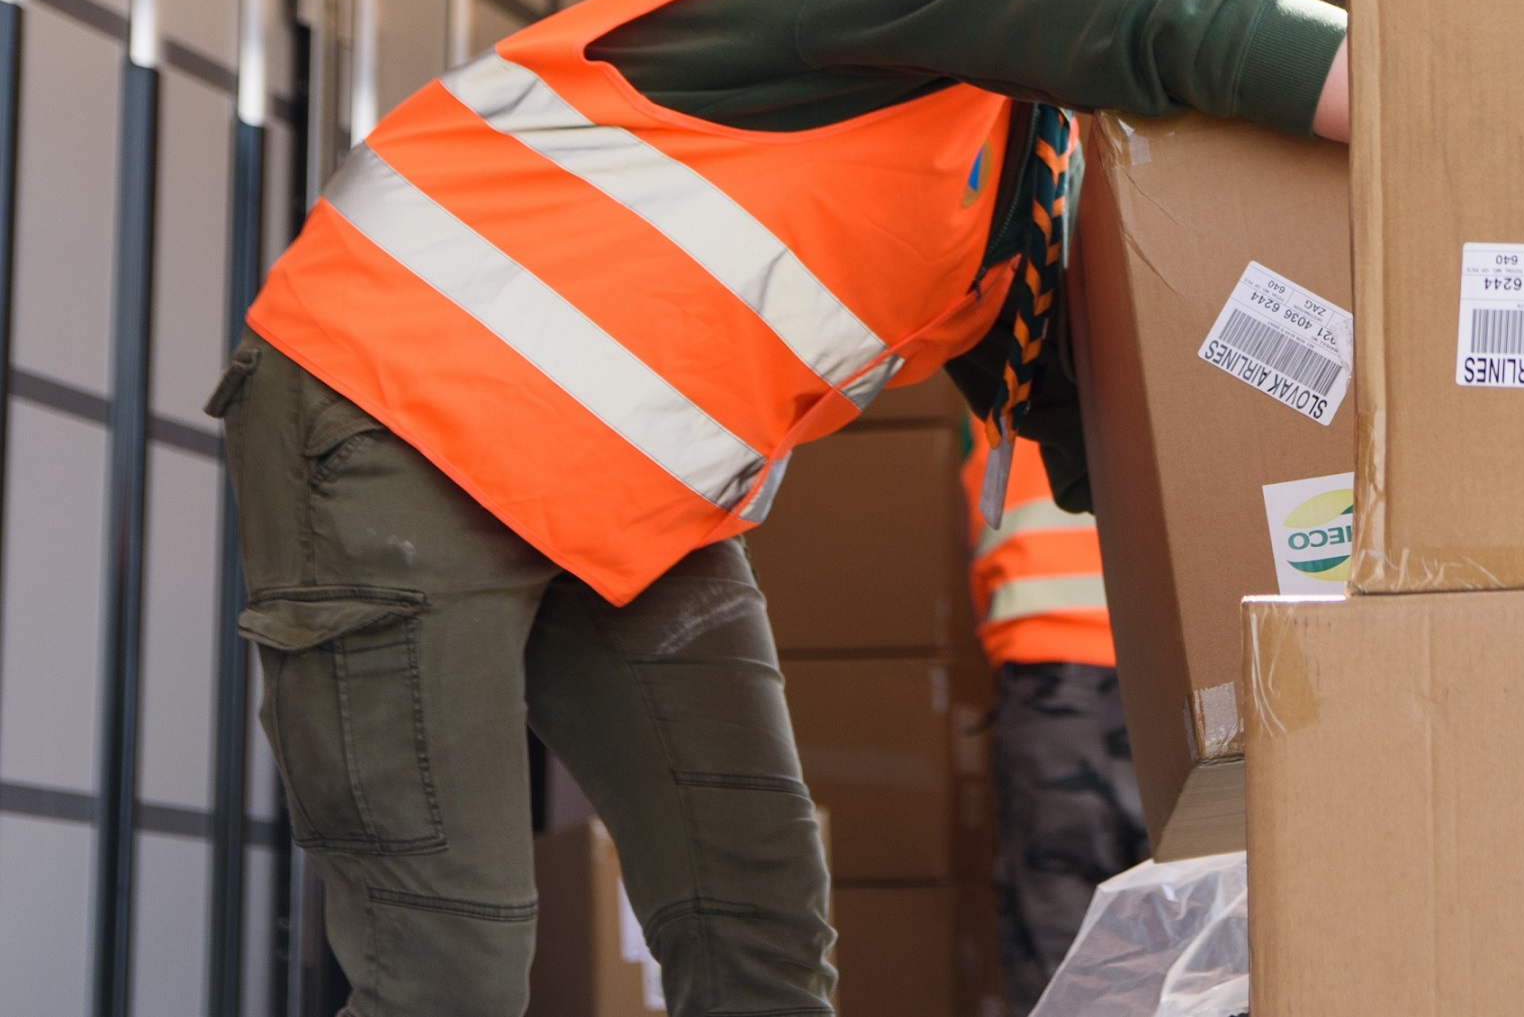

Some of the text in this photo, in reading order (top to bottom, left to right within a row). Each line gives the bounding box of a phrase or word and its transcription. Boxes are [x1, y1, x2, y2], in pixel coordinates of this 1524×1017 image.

[1495, 254, 1518, 266] 640
[1268, 280, 1286, 294] 640
[1483, 277, 1522, 291] 6244
[1250, 292, 1281, 313] 6244
[1304, 299, 1327, 317] ZAG
[1283, 309, 1313, 330] 4036
[1204, 339, 1328, 420] SLOVAK AIRLINES
